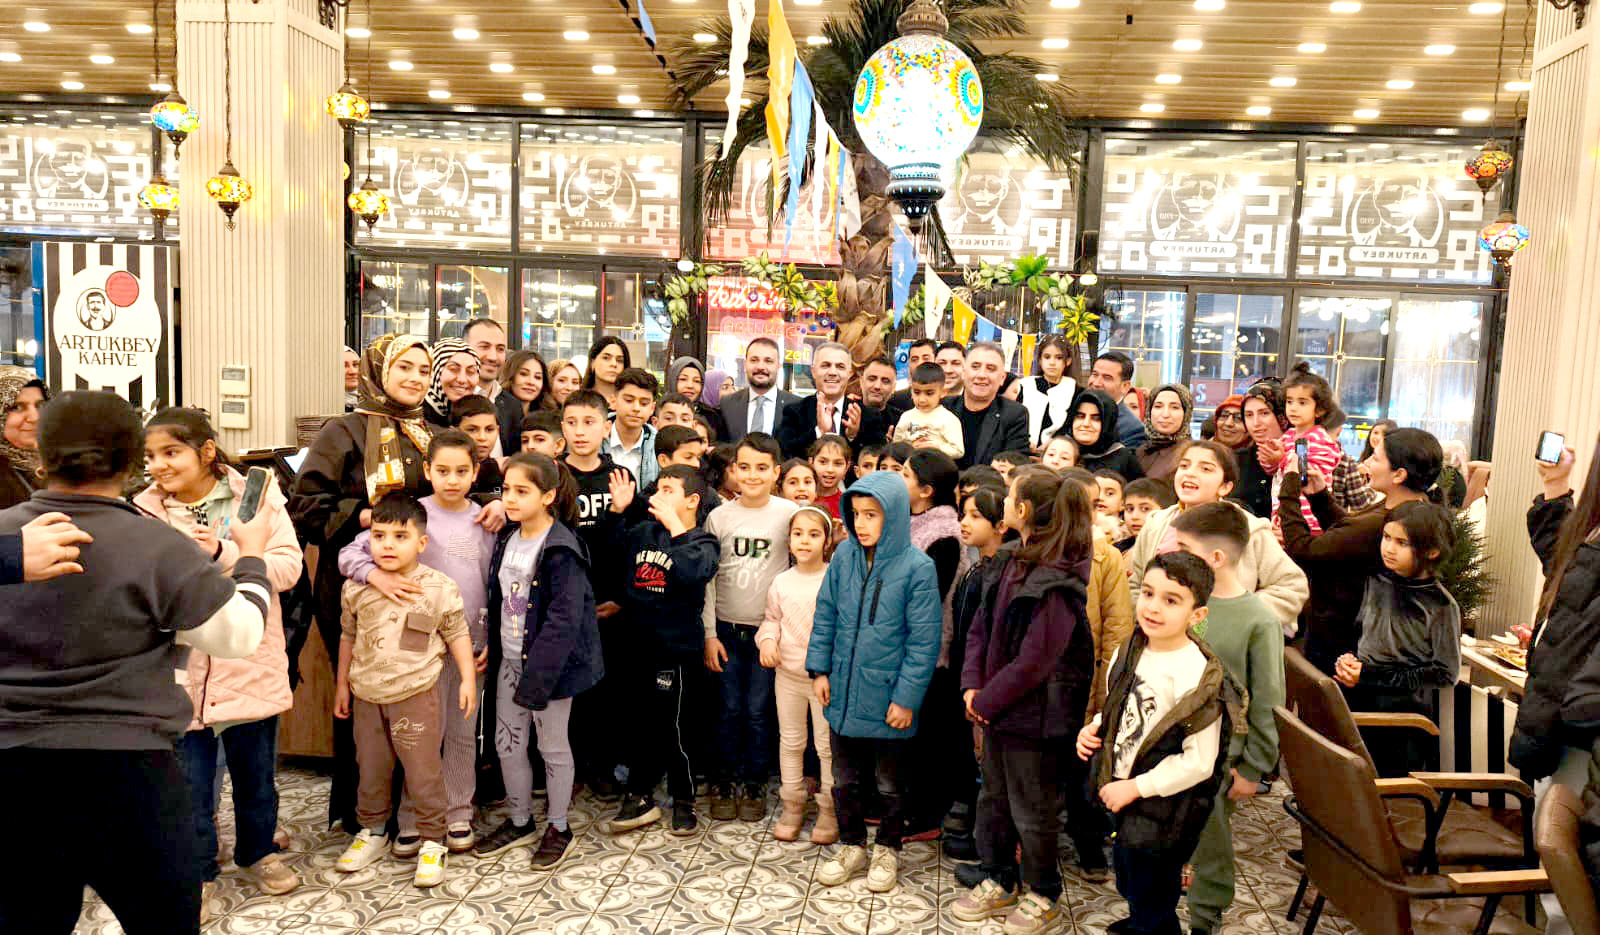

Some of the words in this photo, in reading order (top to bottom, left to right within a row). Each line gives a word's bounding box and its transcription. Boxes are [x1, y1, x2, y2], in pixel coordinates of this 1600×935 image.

[60, 334, 157, 353] ARTUKBEY
[79, 351, 138, 367] KAHVE
[734, 538, 770, 557] UP
